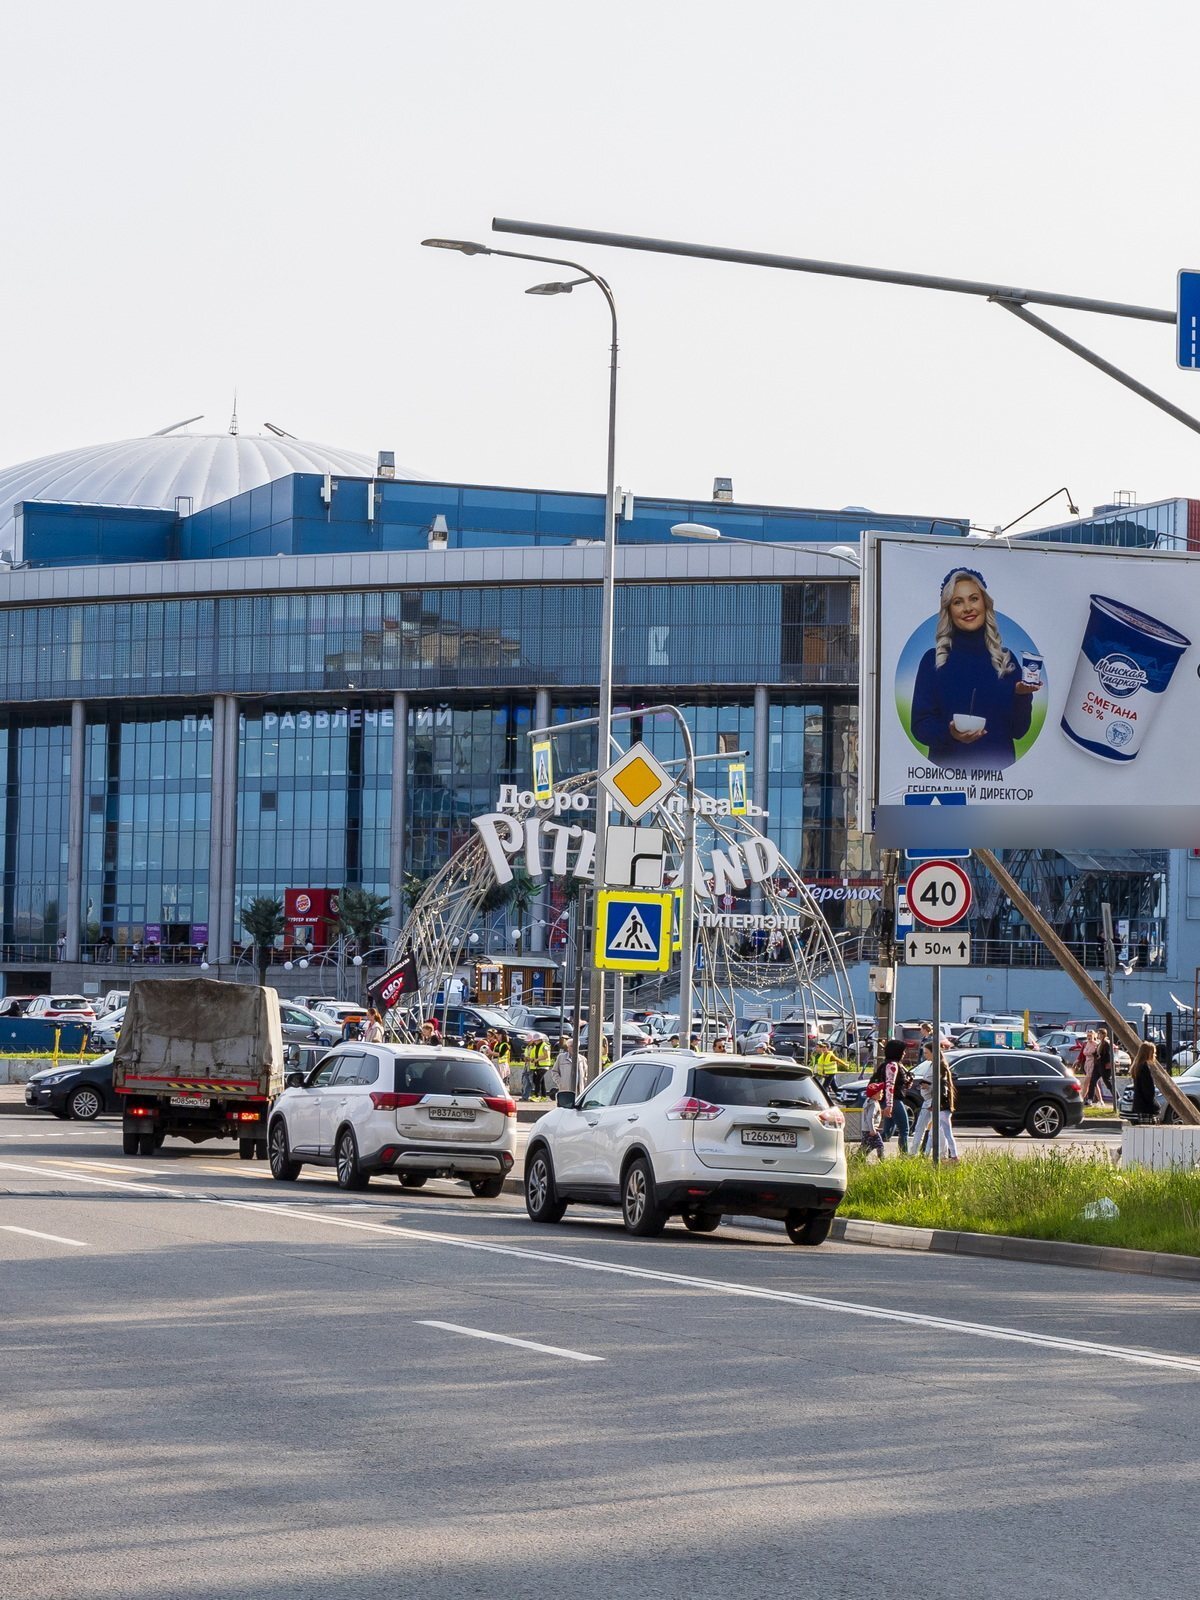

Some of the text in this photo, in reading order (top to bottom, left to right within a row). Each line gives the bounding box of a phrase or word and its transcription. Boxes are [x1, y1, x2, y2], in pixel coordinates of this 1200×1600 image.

[1095, 659, 1145, 679] Минская
[1102, 675, 1137, 688] марка
[1081, 702, 1104, 720] 26 %
[1087, 691, 1138, 721] СМЕТАНА
[264, 703, 452, 730] РАЗВЛЕЧЕИЙ
[907, 766, 1004, 782] НОВИКОВА ИРИНА
[979, 787, 1034, 801] ДИРЕКТОР
[804, 883, 882, 903] Теремок
[919, 881, 957, 907] 40
[745, 1131, 781, 1142] Т266ХМ
